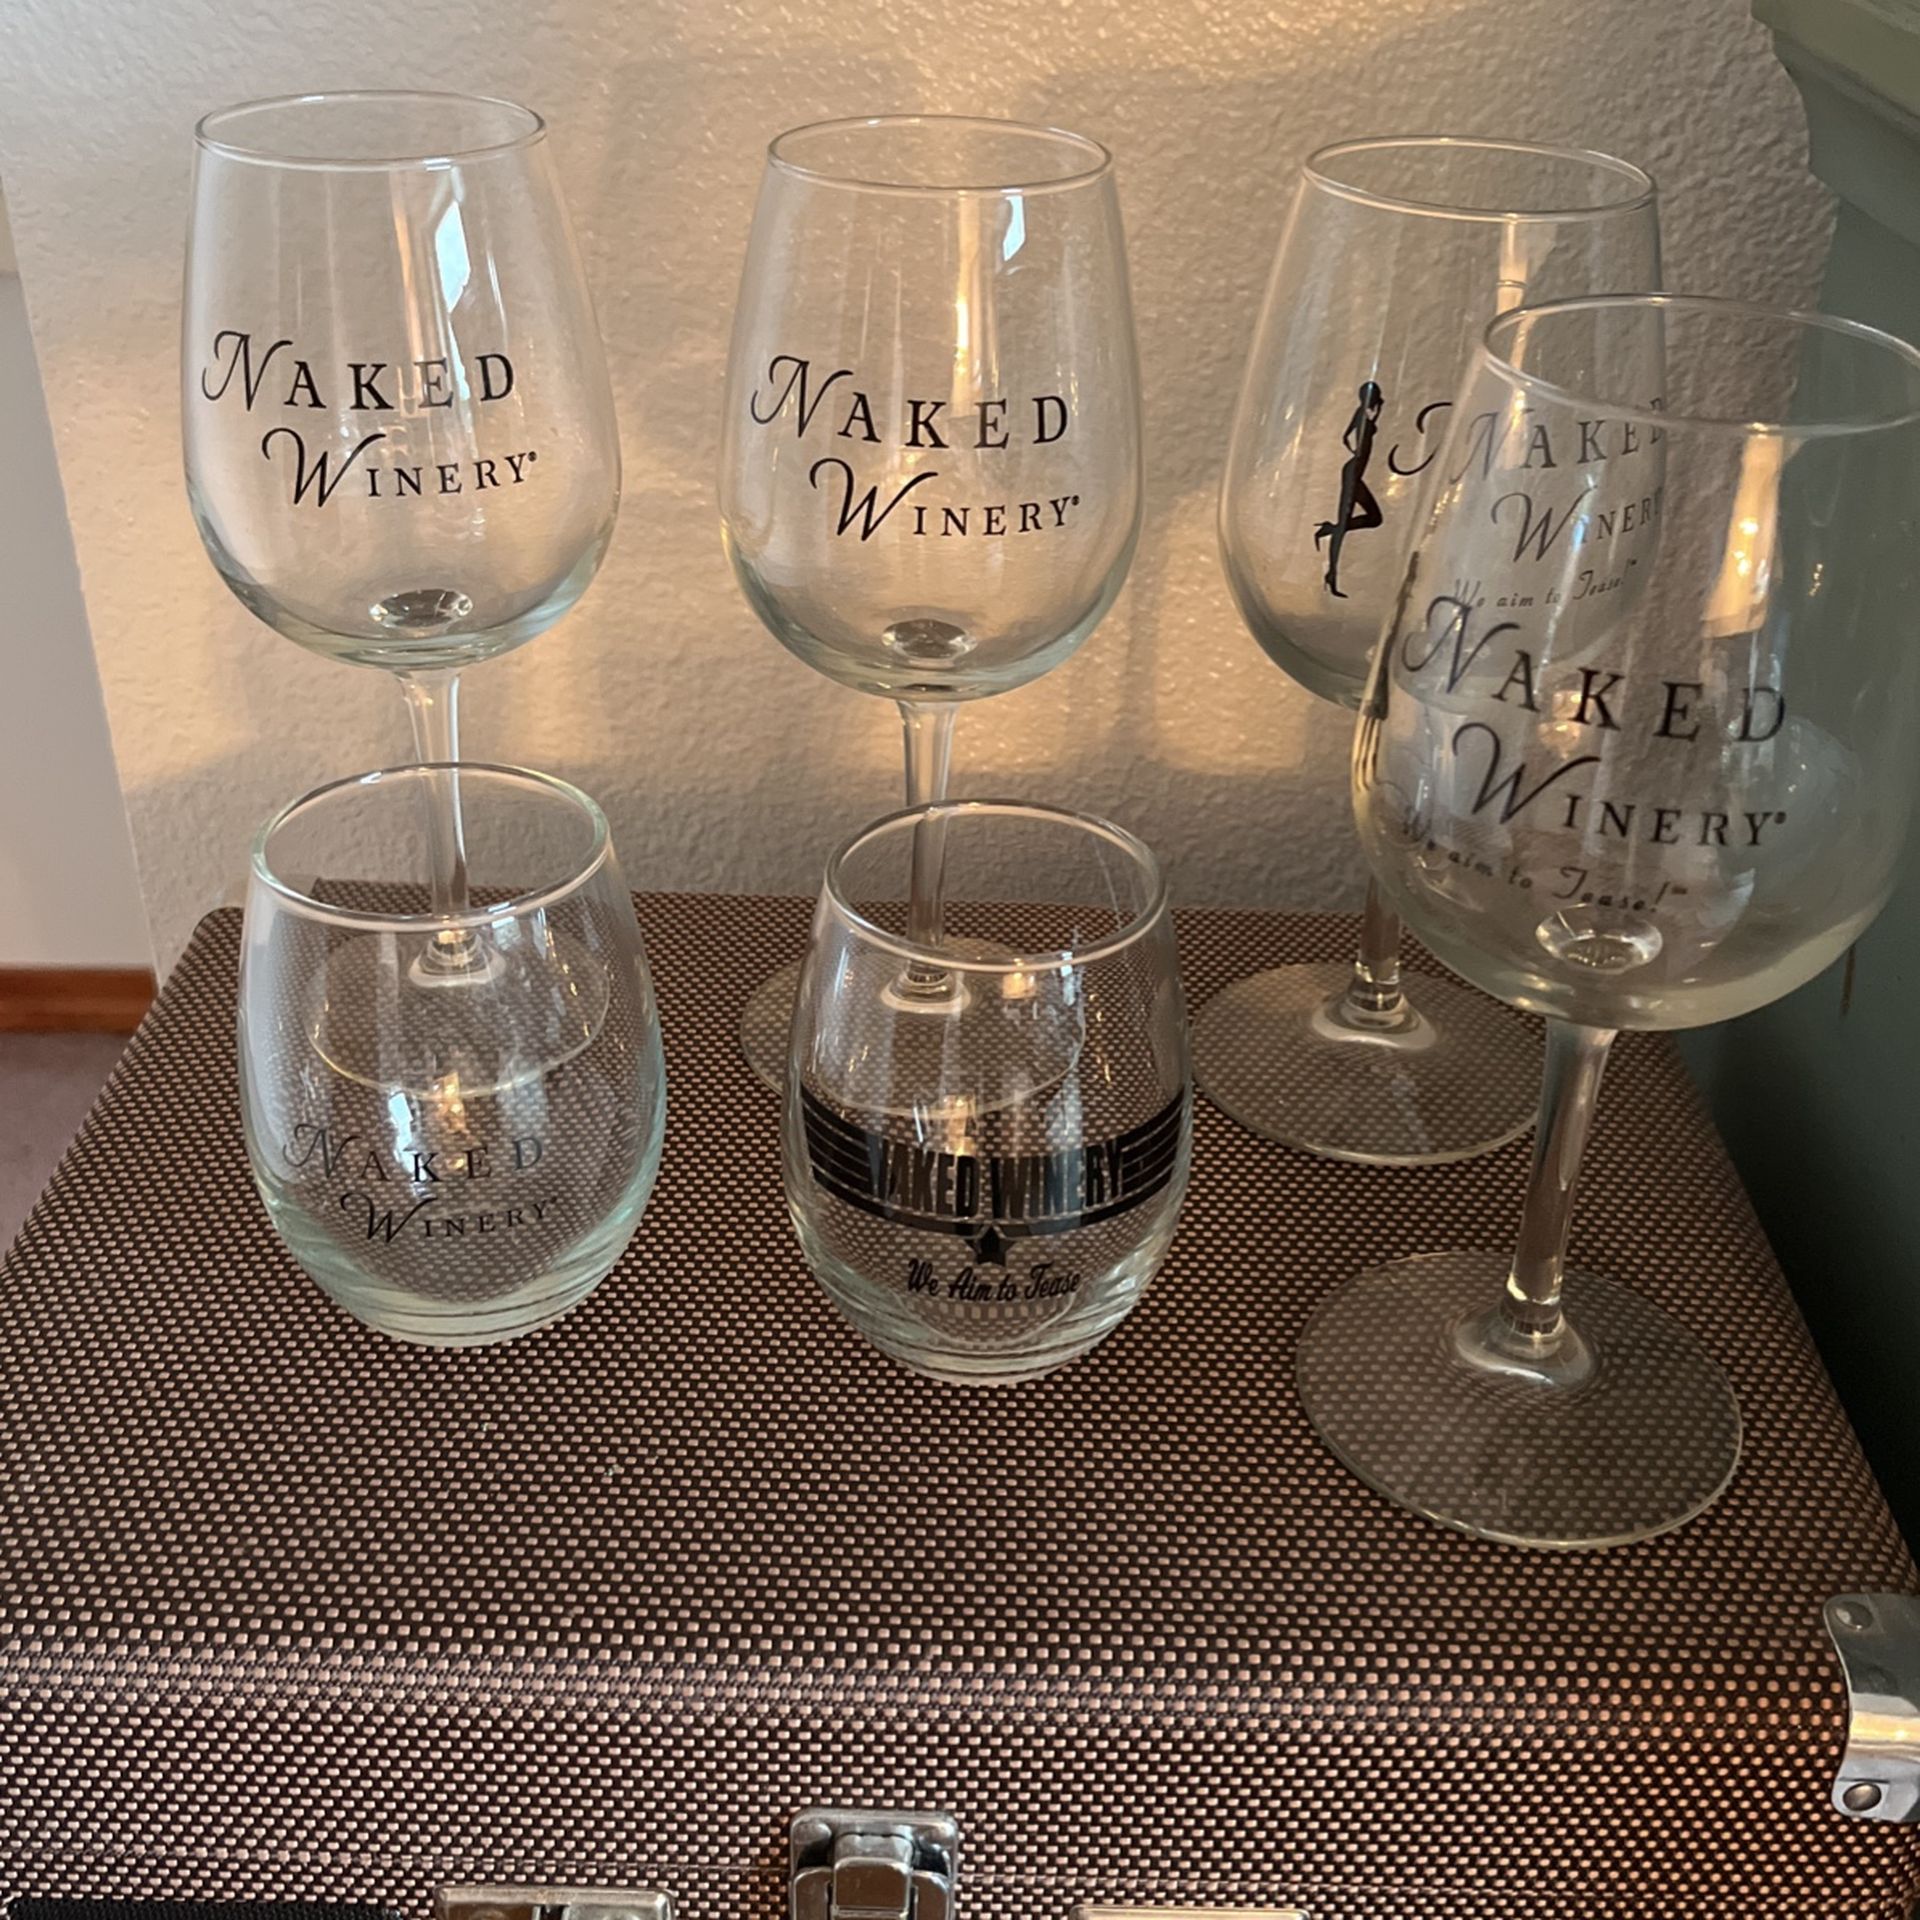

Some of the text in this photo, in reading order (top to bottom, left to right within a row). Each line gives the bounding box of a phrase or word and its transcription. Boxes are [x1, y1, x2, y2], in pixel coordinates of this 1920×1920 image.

[202, 330, 515, 412] NAKED
[751, 354, 1069, 449] NAKED
[1401, 596, 1786, 743] NAKED
[1508, 865, 1533, 889] to
[283, 1123, 543, 1183] NAKED
[988, 1138, 1122, 1219] WINERY
[907, 1258, 1081, 1301] We Aim to Tease
